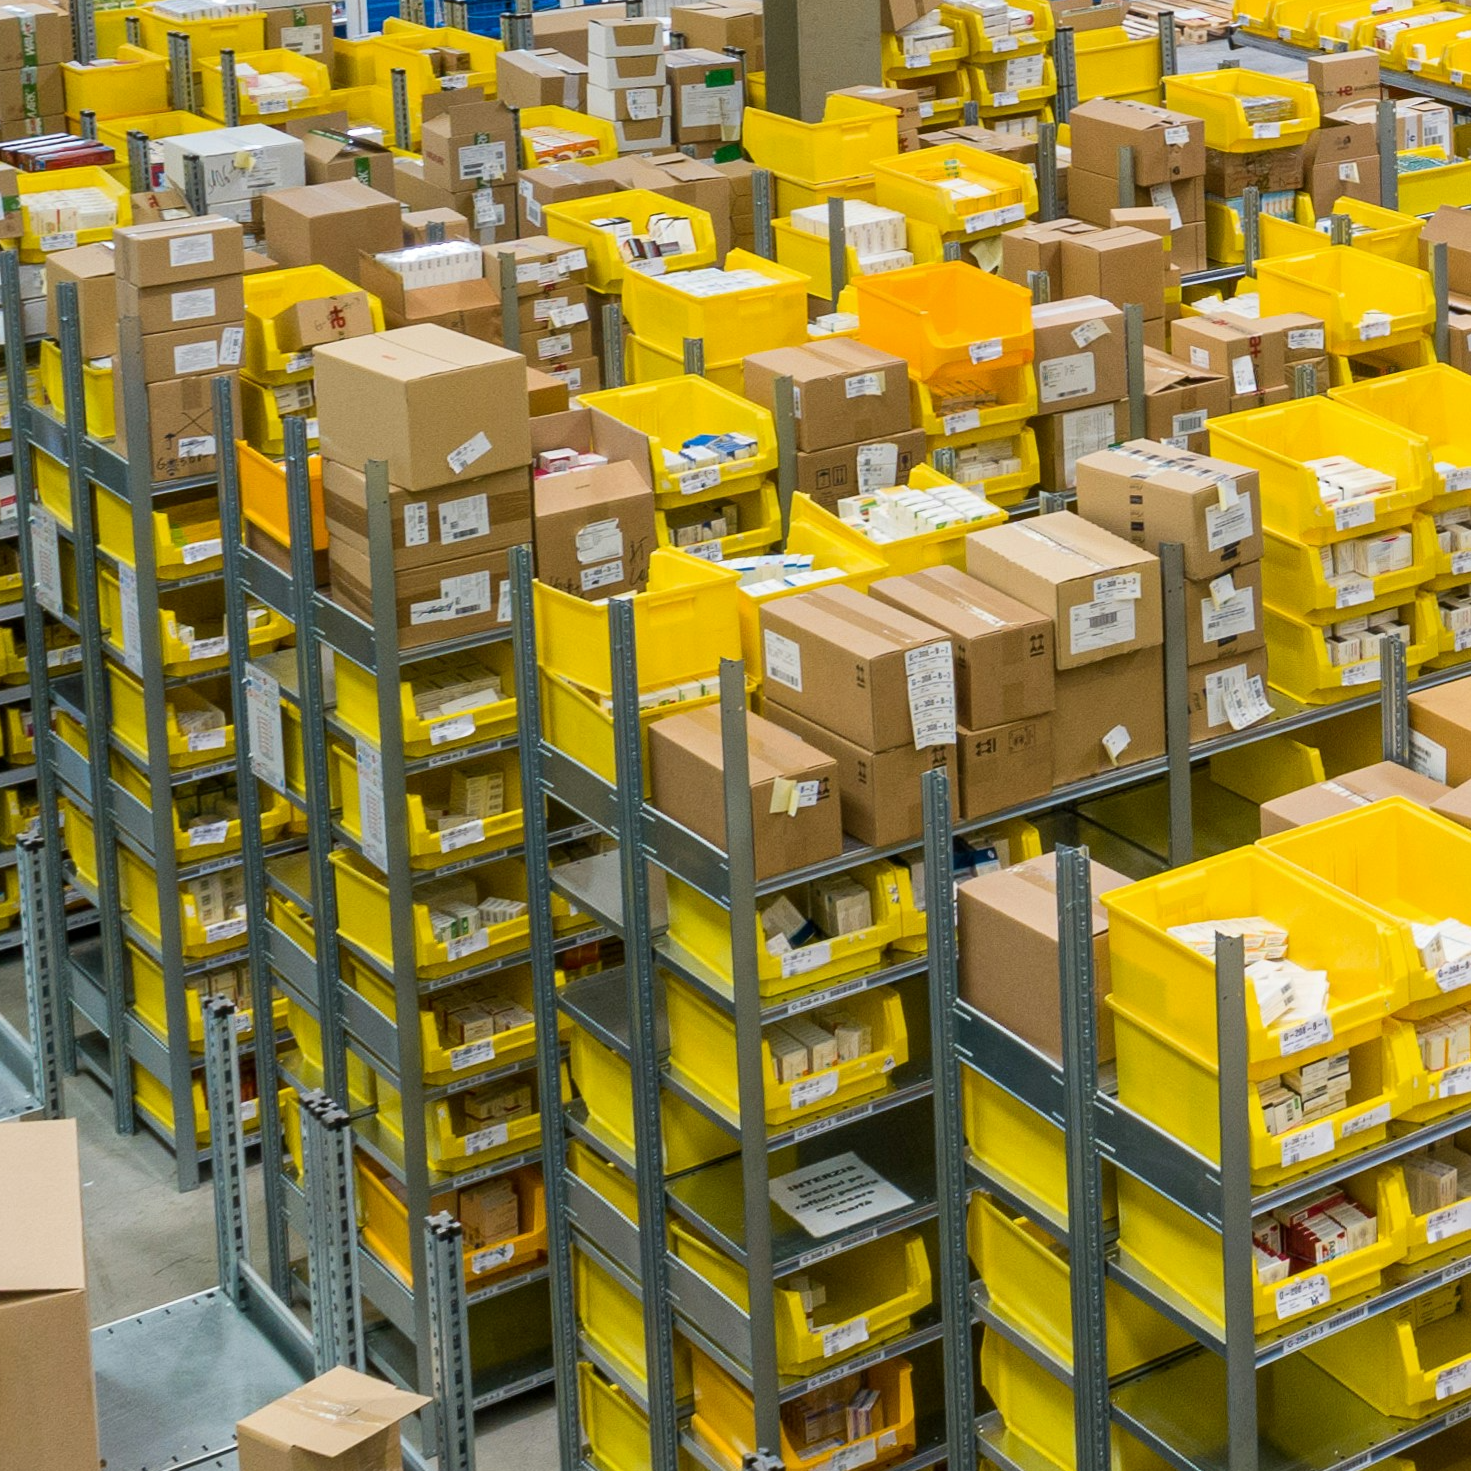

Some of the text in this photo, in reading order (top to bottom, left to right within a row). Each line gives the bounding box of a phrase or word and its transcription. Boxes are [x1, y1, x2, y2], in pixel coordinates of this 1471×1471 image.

[787, 1165, 857, 1192] INTERZIS
[799, 1174, 864, 1198] urcatul pe
[795, 1179, 879, 1211] rafturi pentru
[816, 1190, 875, 1213] accesare
